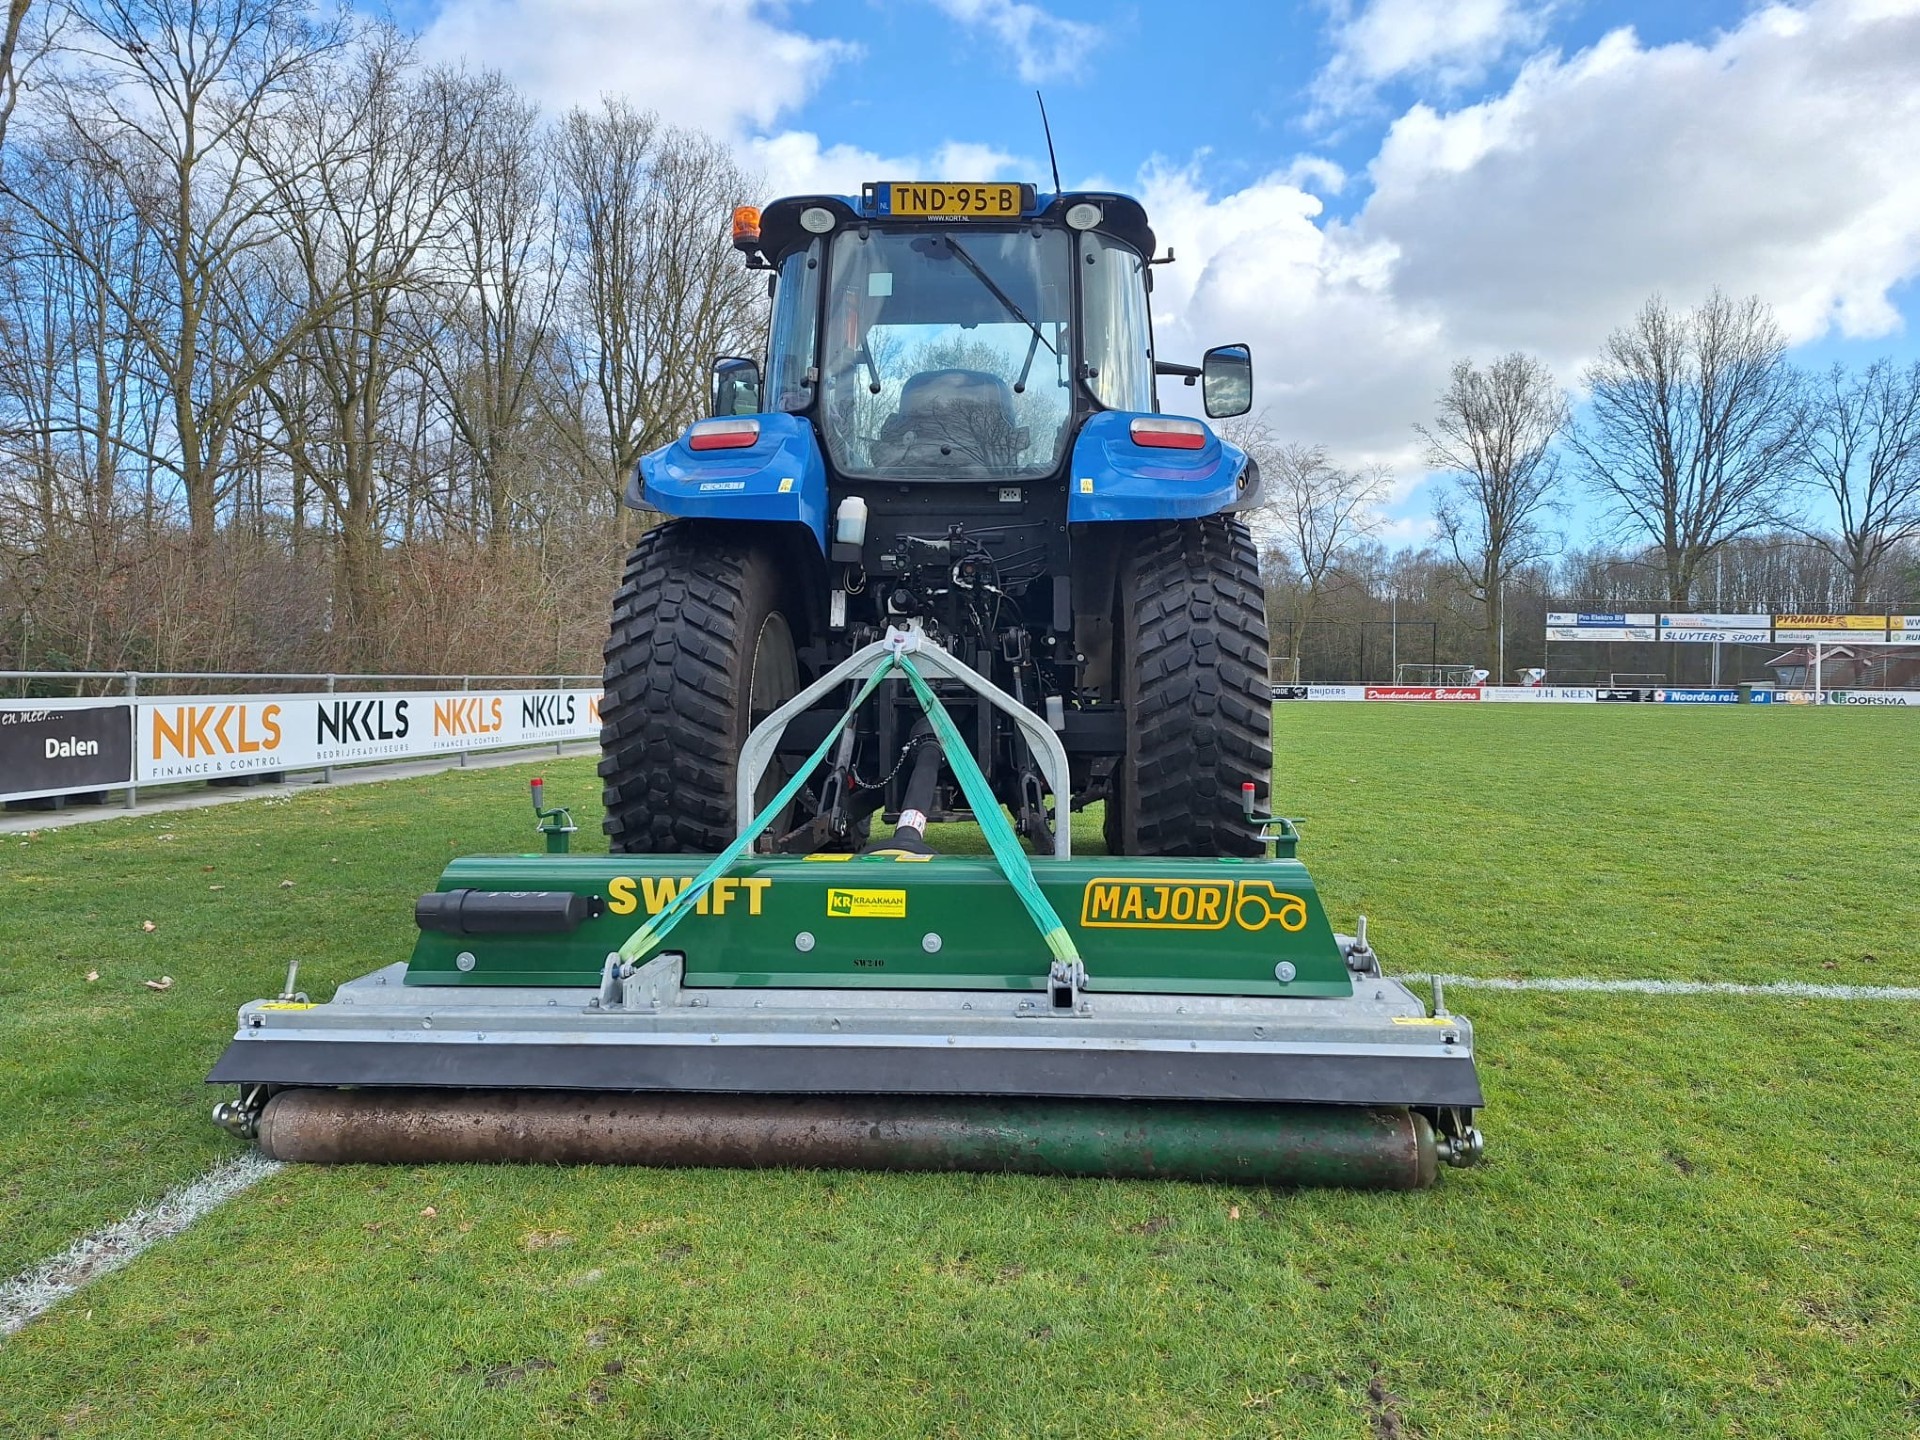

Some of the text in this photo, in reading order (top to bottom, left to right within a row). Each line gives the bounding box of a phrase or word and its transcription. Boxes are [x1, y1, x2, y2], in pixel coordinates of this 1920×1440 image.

[896, 187, 1013, 212] TND-95-B
[879, 202, 888, 210] NL
[1776, 615, 1836, 624] PYRAMIDE
[1664, 631, 1766, 642] SLUYTERS SPORT
[1778, 632, 1815, 640] mediasign
[1309, 688, 1346, 696] SNIJDERS
[1368, 690, 1431, 699] Drankenhandel
[1435, 689, 1476, 699] Beukers
[1535, 690, 1557, 698] J.H.
[1561, 690, 1594, 698] KEEN
[1671, 691, 1716, 701] Noorden
[2, 713, 17, 725] en
[45, 736, 98, 759] Dalen
[317, 744, 409, 759] BEDRIJFSADVISEURS
[153, 757, 282, 777] FINANCE & CONTROL
[833, 896, 852, 907] KR
[854, 897, 904, 905] KRAAKMAN
[1091, 886, 1222, 921] MAJOR
